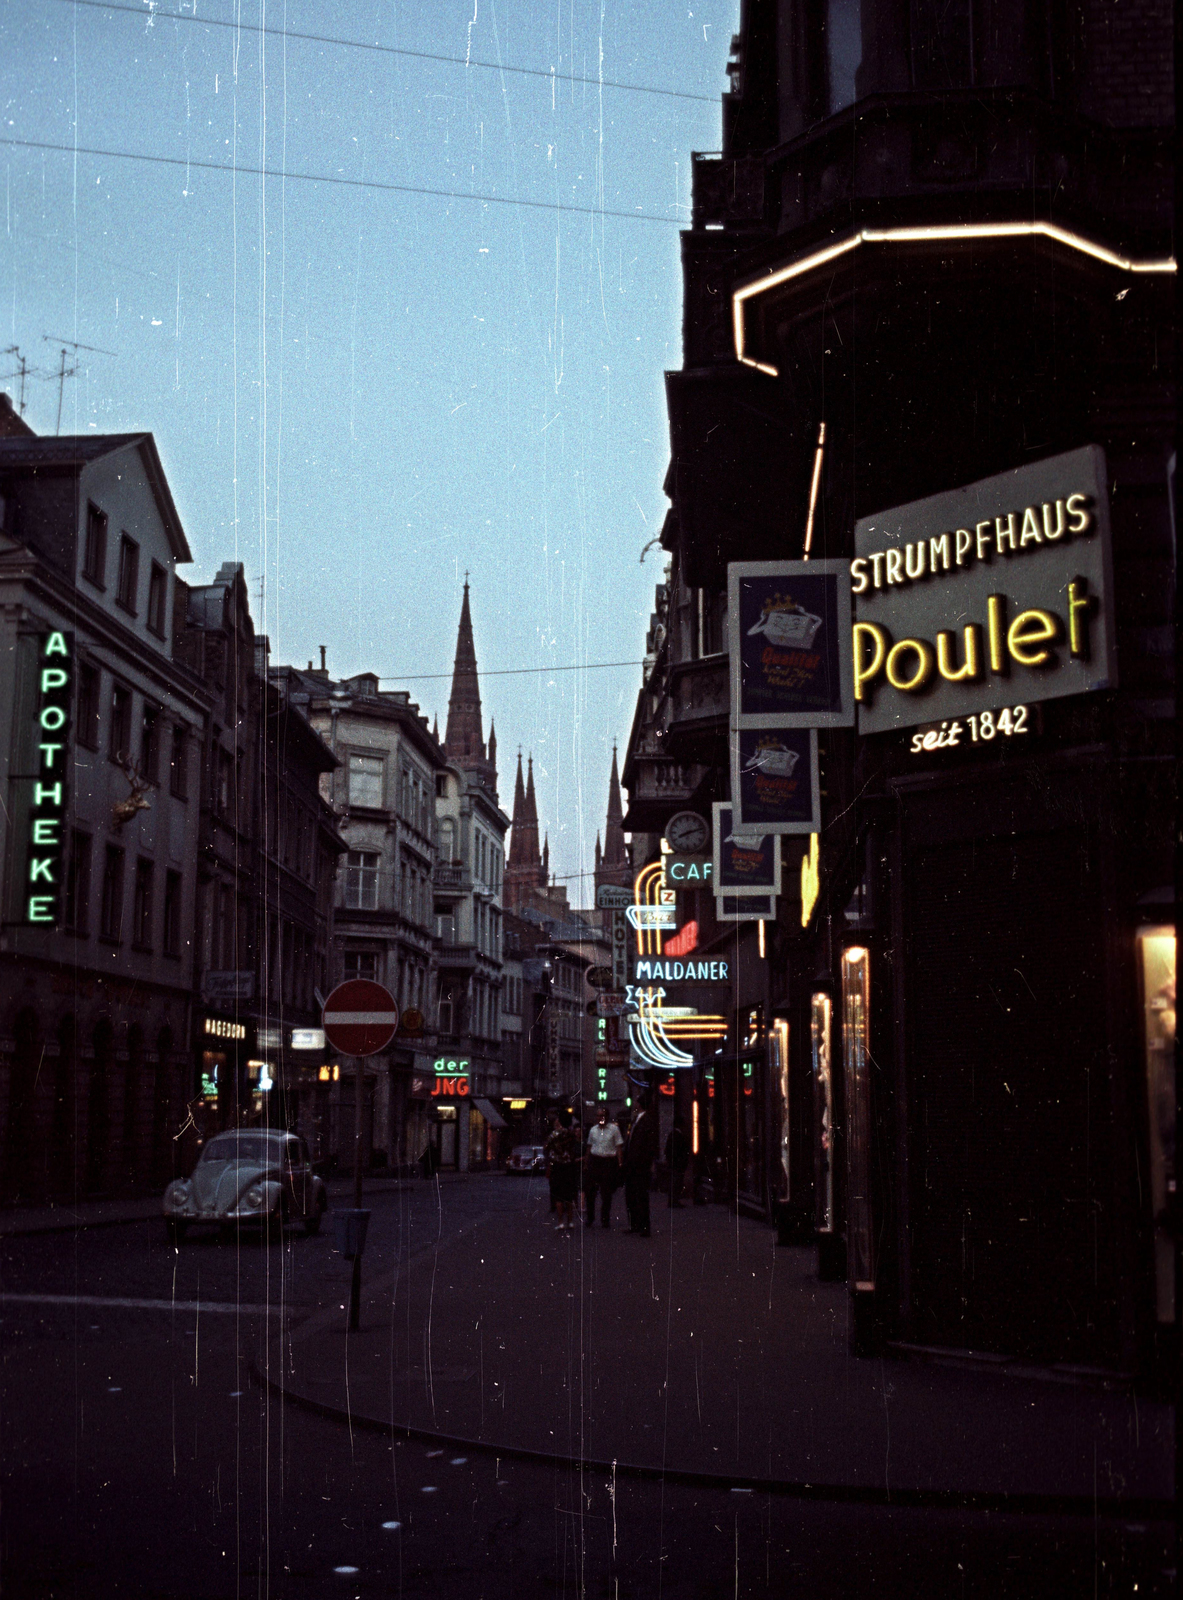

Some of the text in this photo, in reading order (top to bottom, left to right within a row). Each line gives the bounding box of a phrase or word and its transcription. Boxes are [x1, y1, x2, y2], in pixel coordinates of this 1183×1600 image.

[851, 494, 1090, 593] STRUMPFHAUS
[853, 582, 1088, 700] Poulet
[910, 706, 1028, 753] seit 1842
[29, 632, 69, 922] APOTHEKE
[670, 862, 713, 880] CAF
[614, 910, 625, 988] HOTEL
[636, 961, 729, 980] MALDANER
[433, 1058, 469, 1071] der
